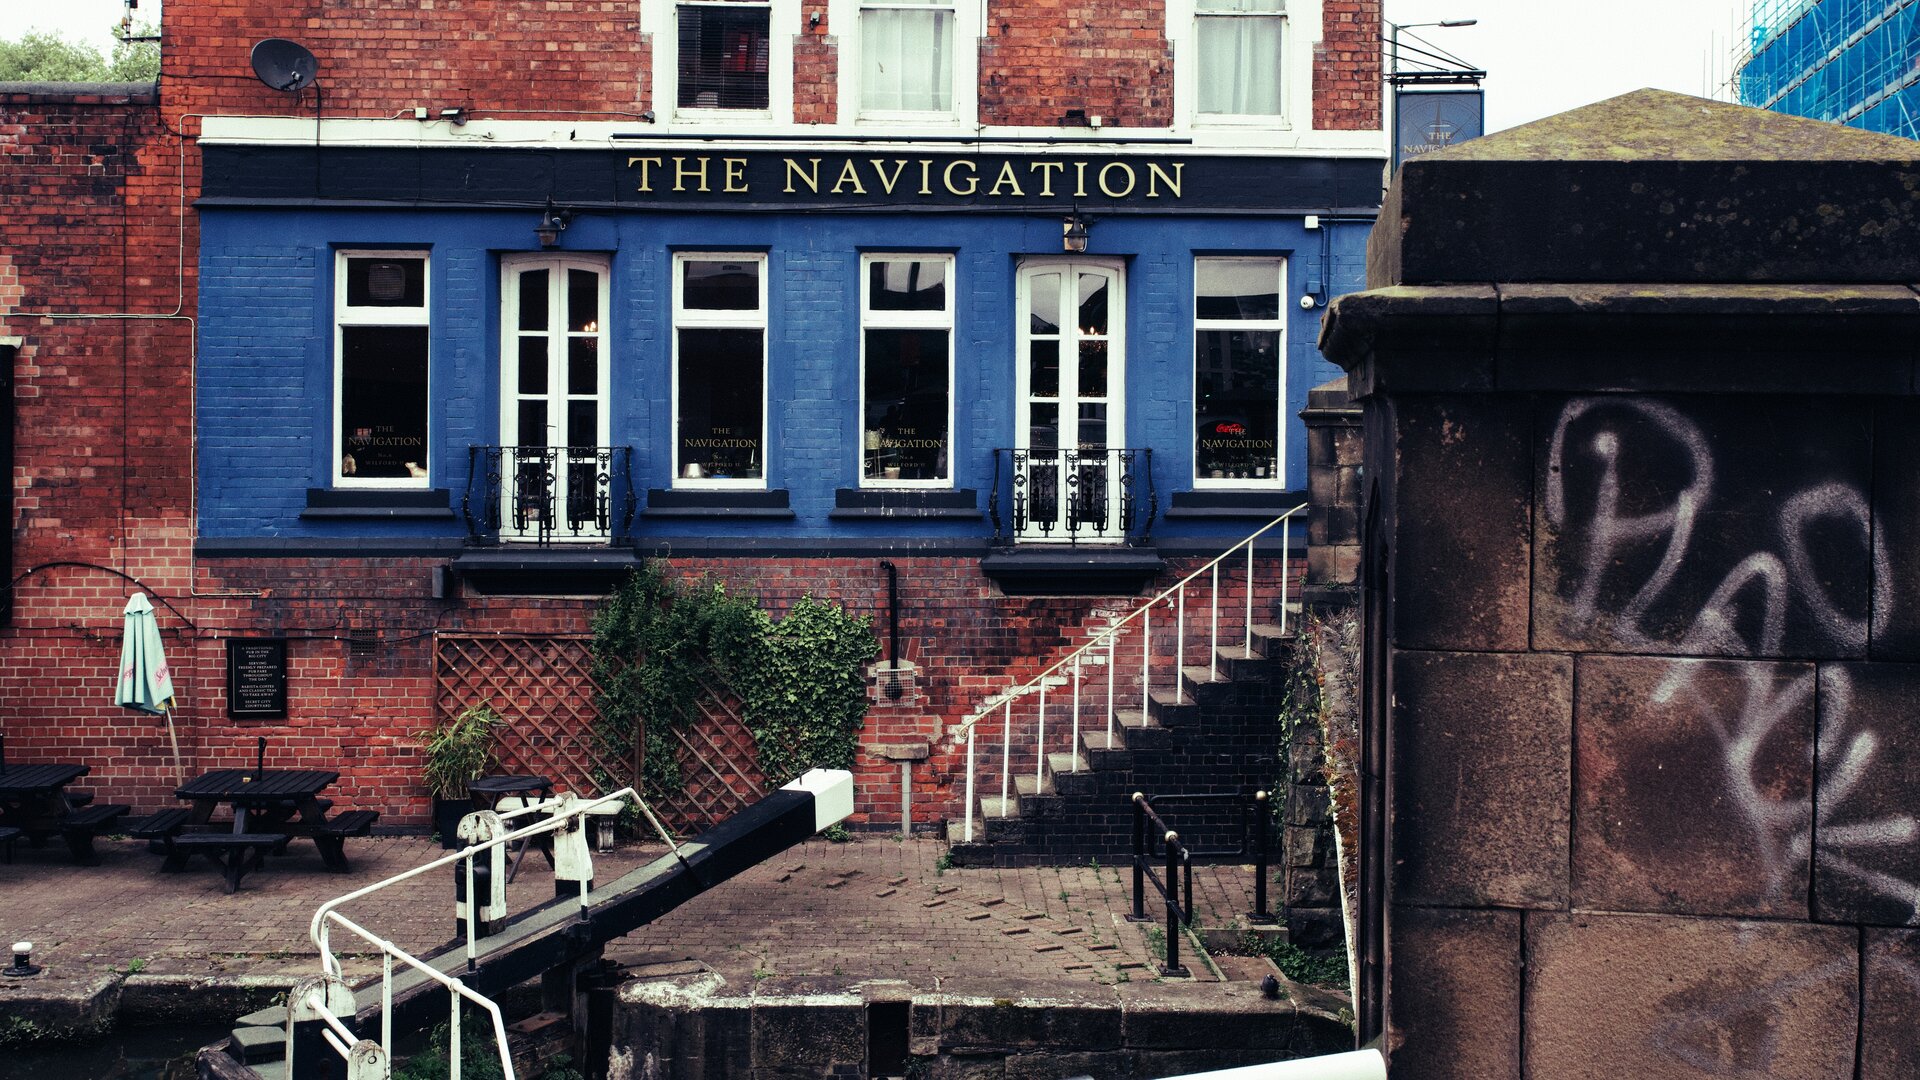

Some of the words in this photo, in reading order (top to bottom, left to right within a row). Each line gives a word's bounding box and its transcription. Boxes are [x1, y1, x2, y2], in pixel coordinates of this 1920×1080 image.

[1428, 132, 1451, 140] THE
[628, 157, 749, 193] THE
[782, 157, 1186, 197] NAVIGATION
[348, 437, 421, 446] NAVIGATION
[685, 439, 757, 448] NAVIGATION
[870, 439, 942, 448] AVIGATION
[1202, 440, 1273, 449] NAVIGATION
